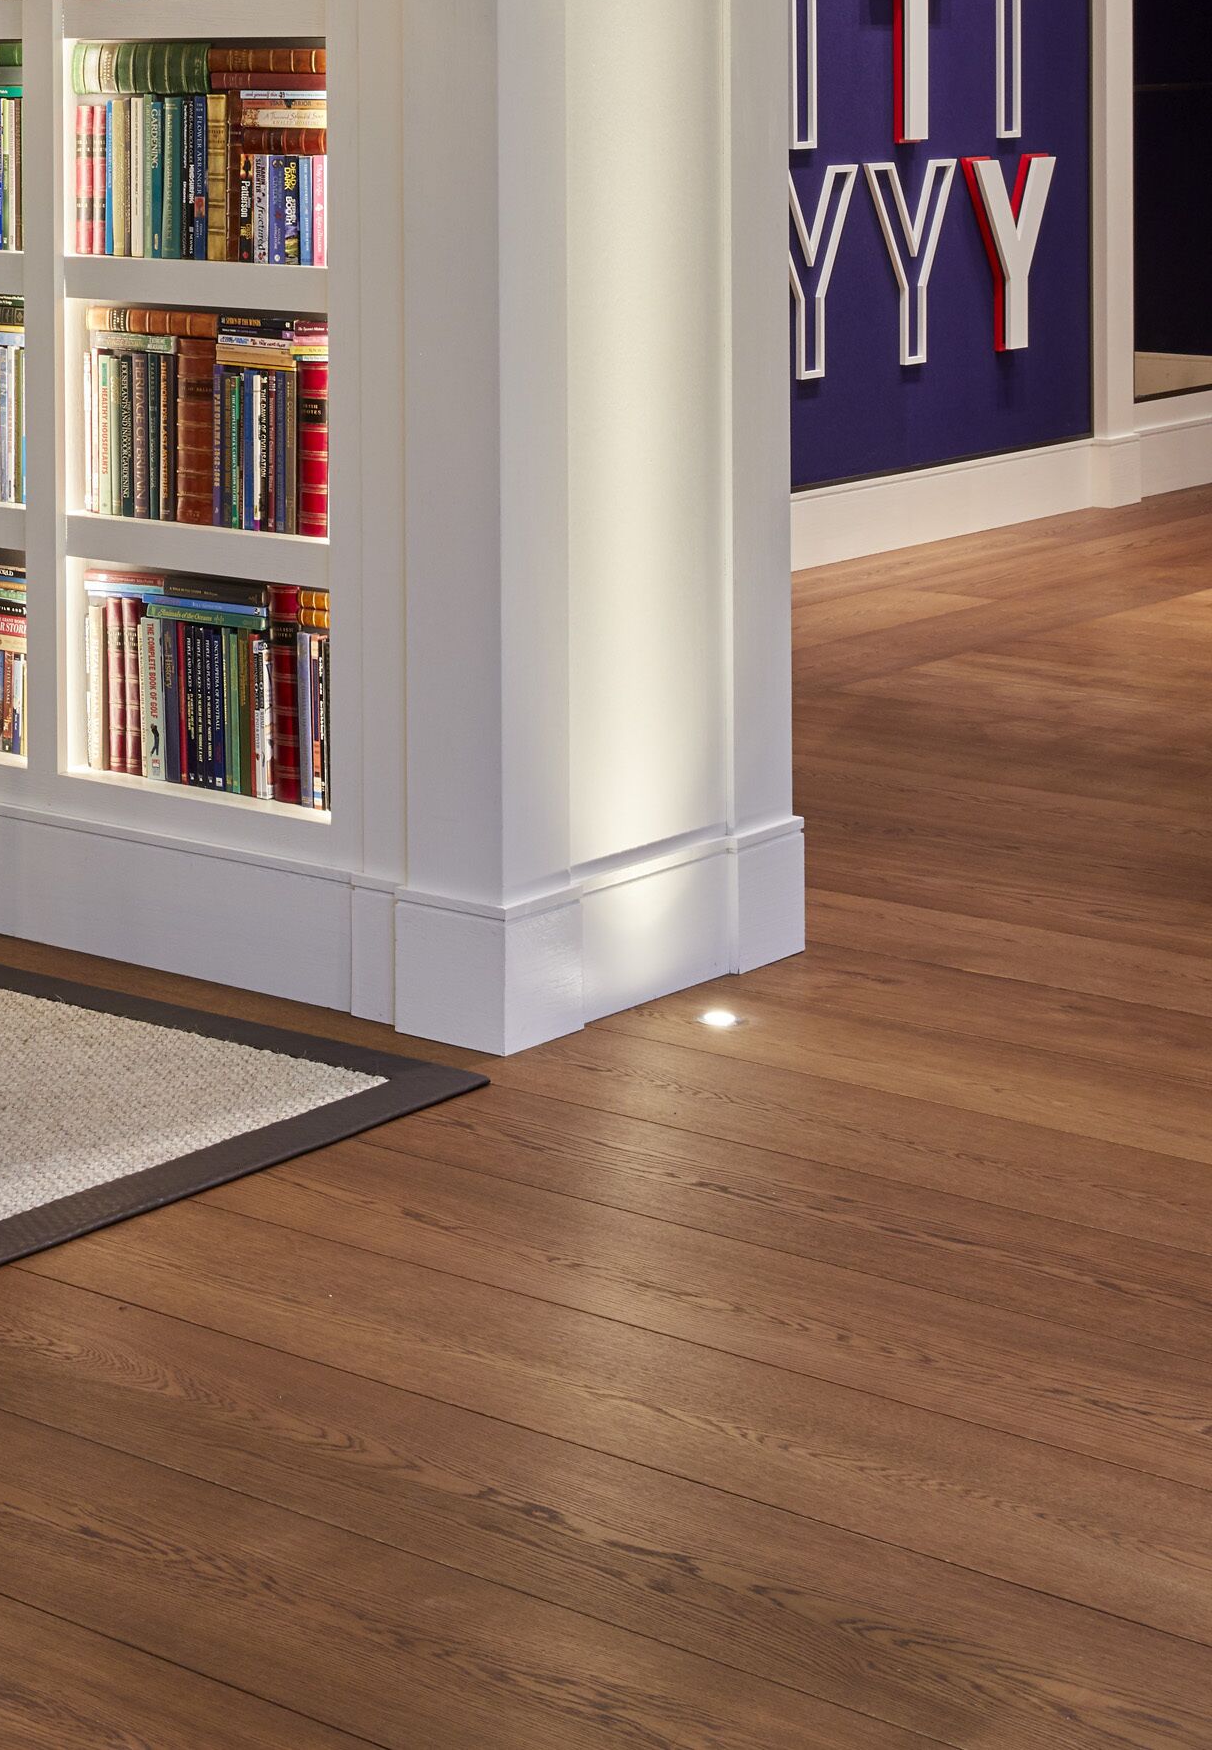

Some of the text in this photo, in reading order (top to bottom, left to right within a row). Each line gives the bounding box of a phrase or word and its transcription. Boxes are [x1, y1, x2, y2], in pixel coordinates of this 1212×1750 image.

[151, 109, 159, 169] GARDENING
[240, 180, 251, 218] Patterson
[134, 359, 146, 499] HERITAGE OF BRITAIN
[147, 623, 155, 636] THE
[148, 636, 157, 719] COMPLETE BOOK OF GOLF
